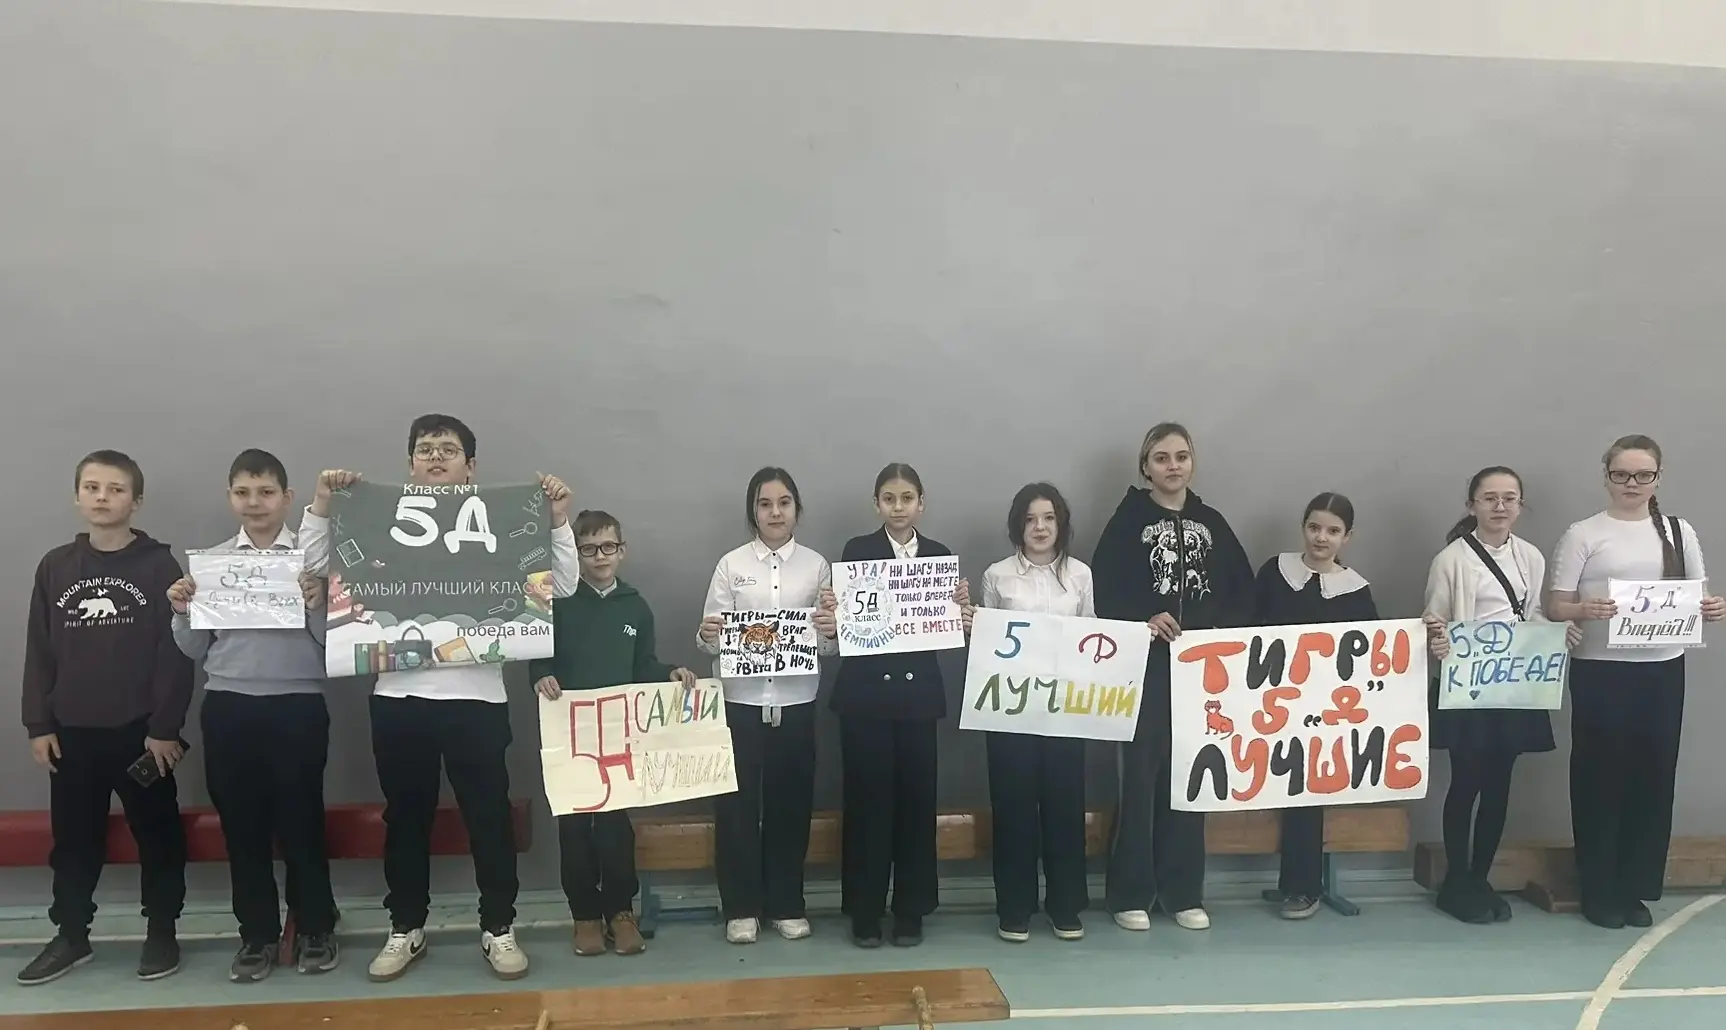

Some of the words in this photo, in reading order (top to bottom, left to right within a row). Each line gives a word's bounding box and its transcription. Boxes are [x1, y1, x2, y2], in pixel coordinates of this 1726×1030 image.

[403, 483, 450, 495] Класс
[454, 483, 479, 495] №1
[389, 495, 497, 554] 5Д
[847, 561, 887, 580] УРА!
[889, 565, 903, 578] НИ
[906, 562, 933, 576] ШАГУ
[935, 562, 958, 574] НАЗАД
[56, 577, 102, 609] MOUNTAIN
[103, 576, 147, 606] EXPLORER
[410, 579, 485, 595] ЛУЧШИЙ
[888, 579, 900, 590] НИ
[900, 577, 921, 590] ШАГУ
[922, 578, 932, 588] НА
[932, 575, 959, 587] МЕСТЕ
[852, 590, 880, 615] 5Д
[895, 591, 922, 603] ТОЛЬКО
[1630, 585, 1655, 614] 5
[720, 610, 765, 625] ТИГРЫ
[777, 609, 807, 621] СИЛА
[854, 613, 881, 623] класс
[900, 607, 907, 617] И
[910, 605, 946, 617] ТОЛЬКО
[456, 625, 516, 639] победа
[520, 625, 550, 636] вам
[782, 624, 807, 636] ВРАГ
[840, 623, 897, 649] ЧЕМПИОНЫ
[895, 622, 916, 636] ВСЕ
[922, 618, 963, 634] ВМЕСТЕ
[994, 621, 1031, 659] 5
[1078, 632, 1118, 664] Д
[1449, 622, 1471, 659] 5
[775, 653, 786, 672] В
[790, 654, 815, 671] НОЧЬ
[1177, 628, 1410, 695] ТИГРЫ
[1448, 664, 1463, 693] К
[973, 673, 1138, 718] ЛУЧШИЙ
[634, 684, 720, 733] САМЫЙ
[1251, 686, 1302, 736] 5
[1186, 724, 1422, 803] ЛУЧШИЕ
